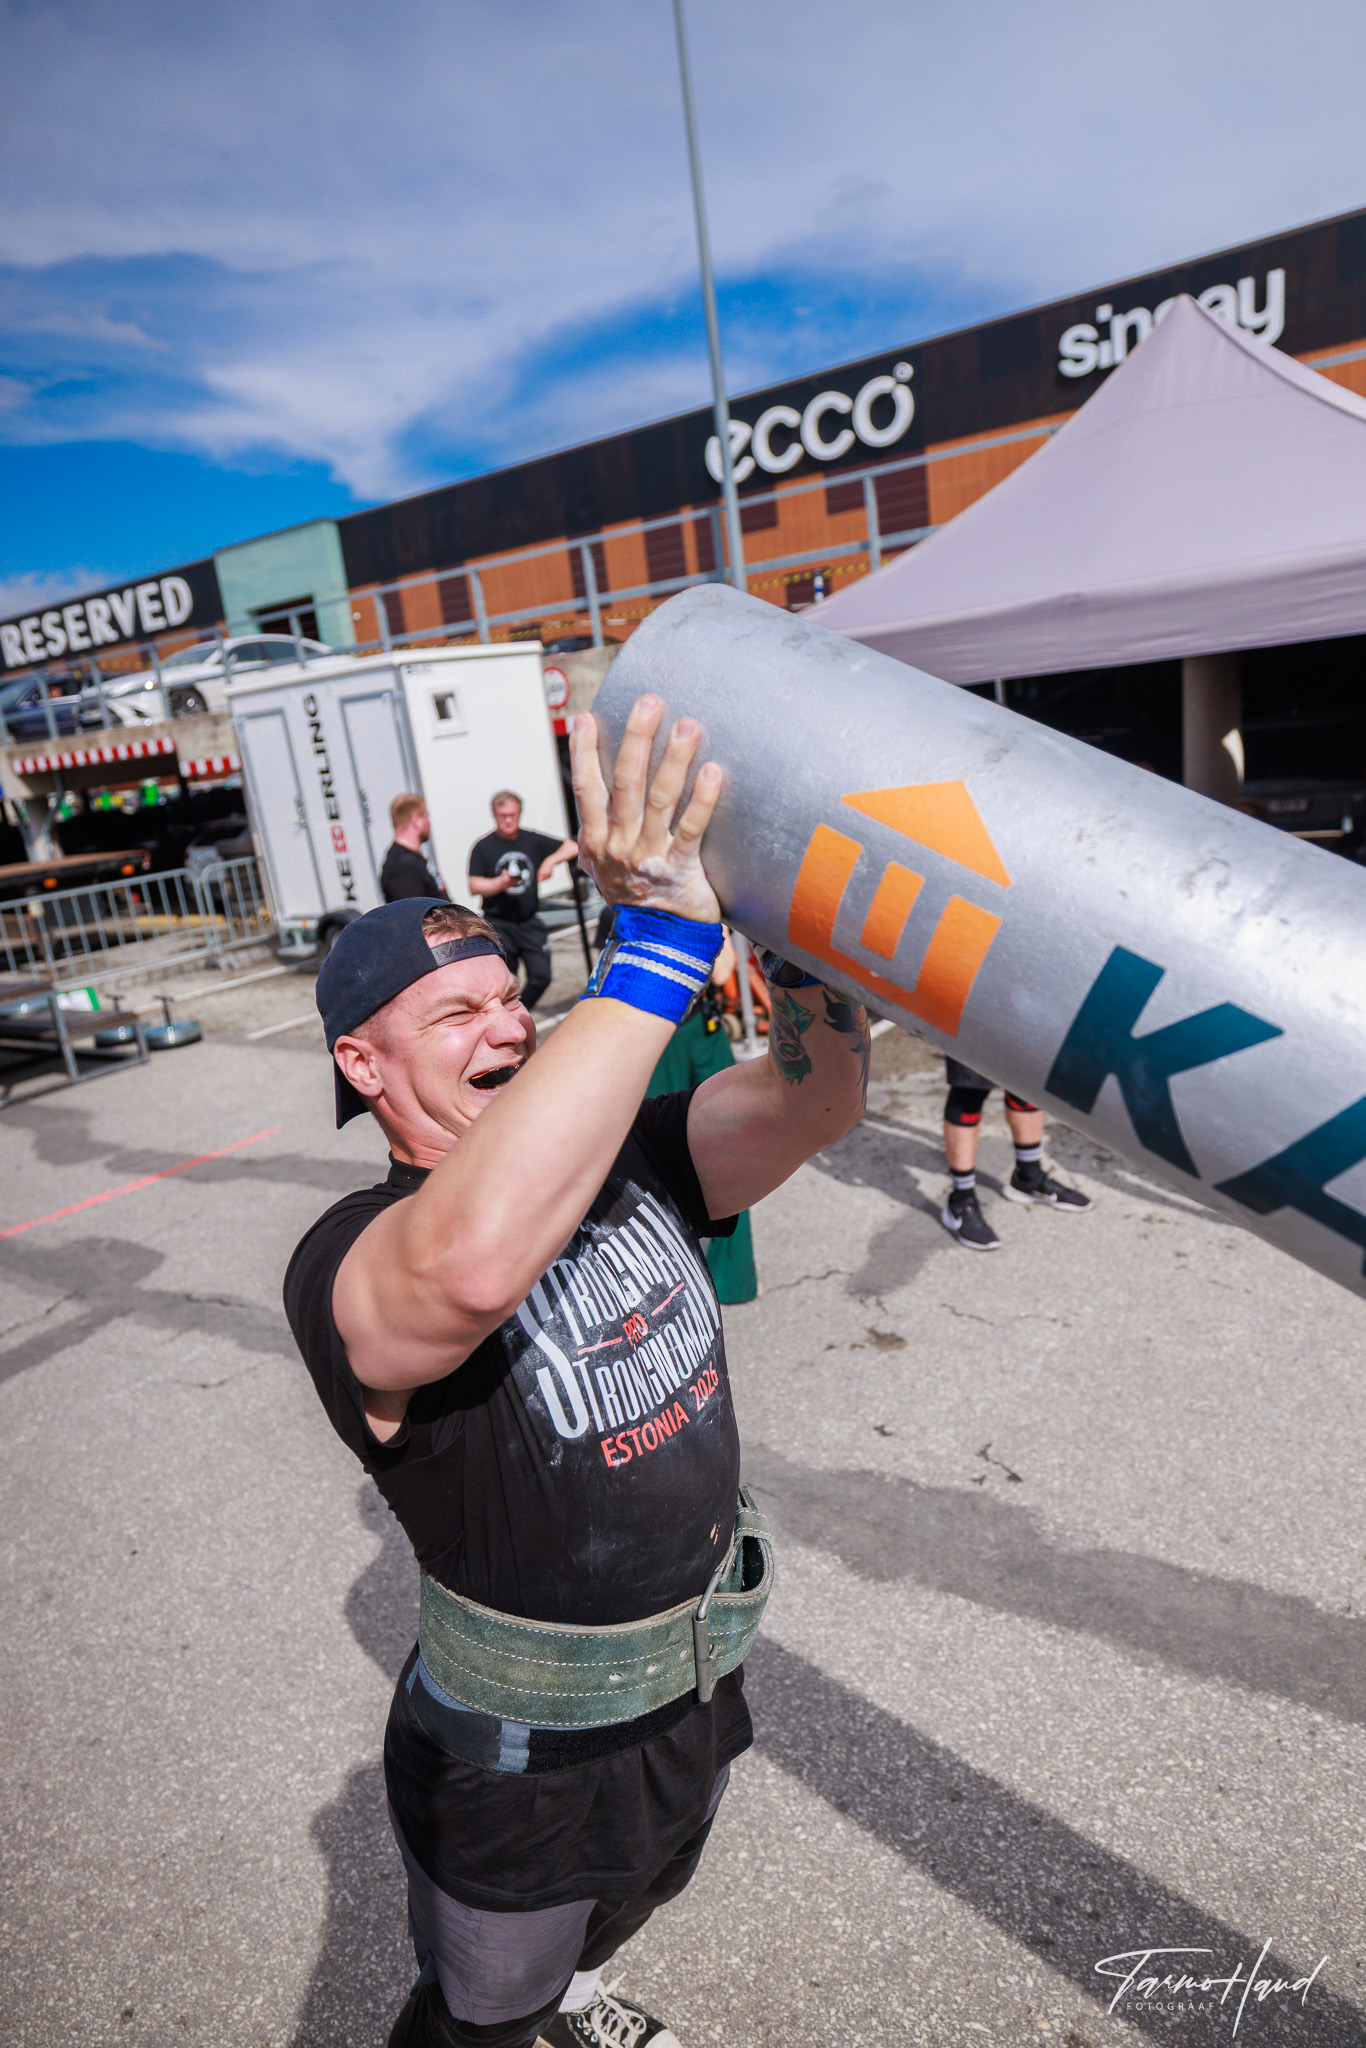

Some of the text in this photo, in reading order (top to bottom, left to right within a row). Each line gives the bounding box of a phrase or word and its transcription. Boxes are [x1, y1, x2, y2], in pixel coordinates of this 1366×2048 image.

[1058, 267, 1285, 378] sinay
[0, 576, 194, 669] RESERVED
[622, 1312, 648, 1346] PRO
[601, 1360, 720, 1467] ESTONIA 2026
